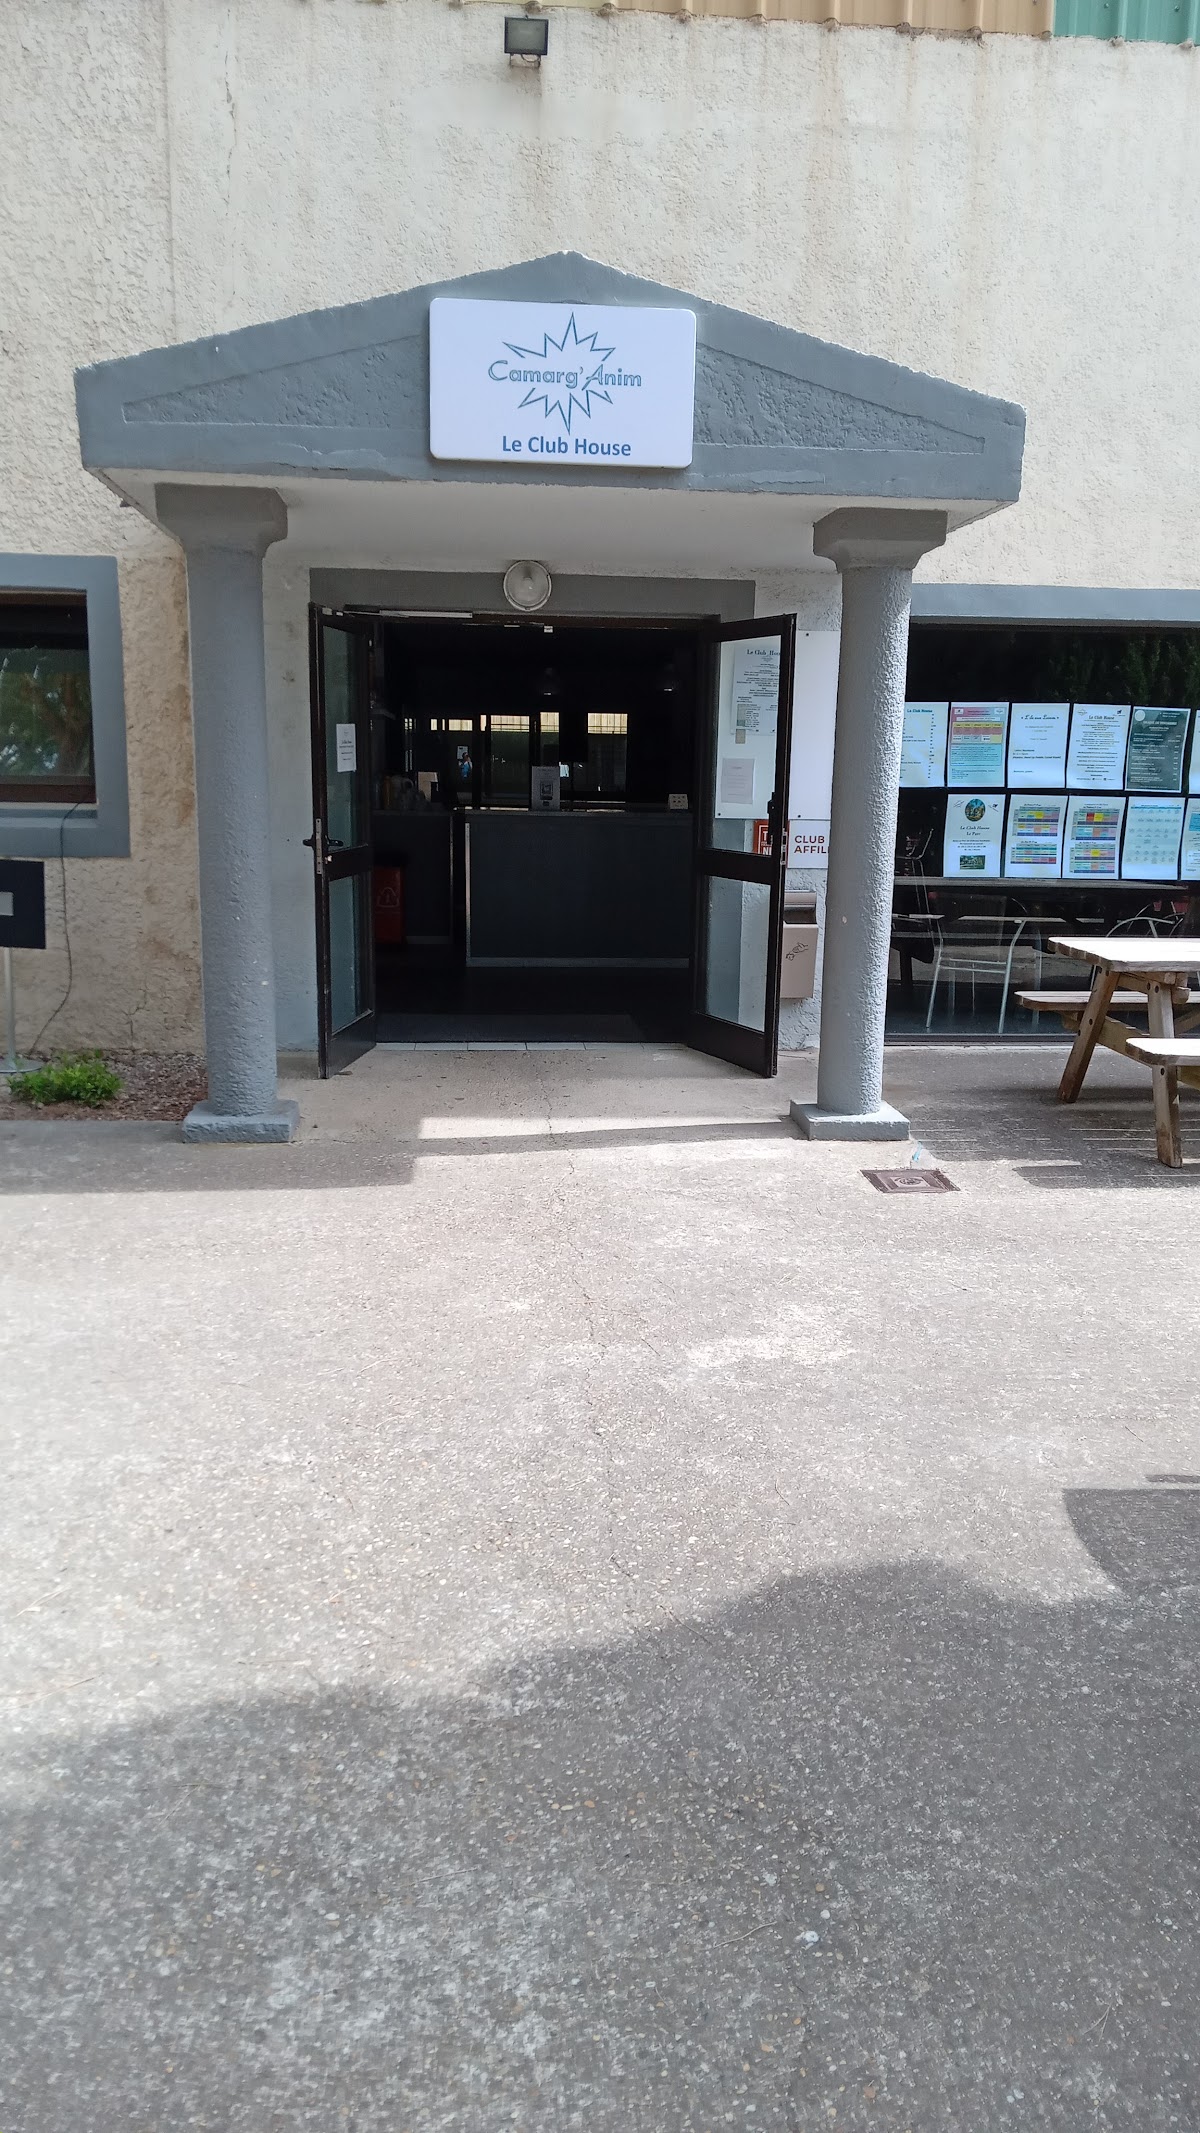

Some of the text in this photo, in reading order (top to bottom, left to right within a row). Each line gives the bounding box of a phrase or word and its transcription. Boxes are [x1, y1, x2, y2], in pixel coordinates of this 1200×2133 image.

[502, 435, 632, 456] Le Club House
[794, 835, 825, 843] CLUB
